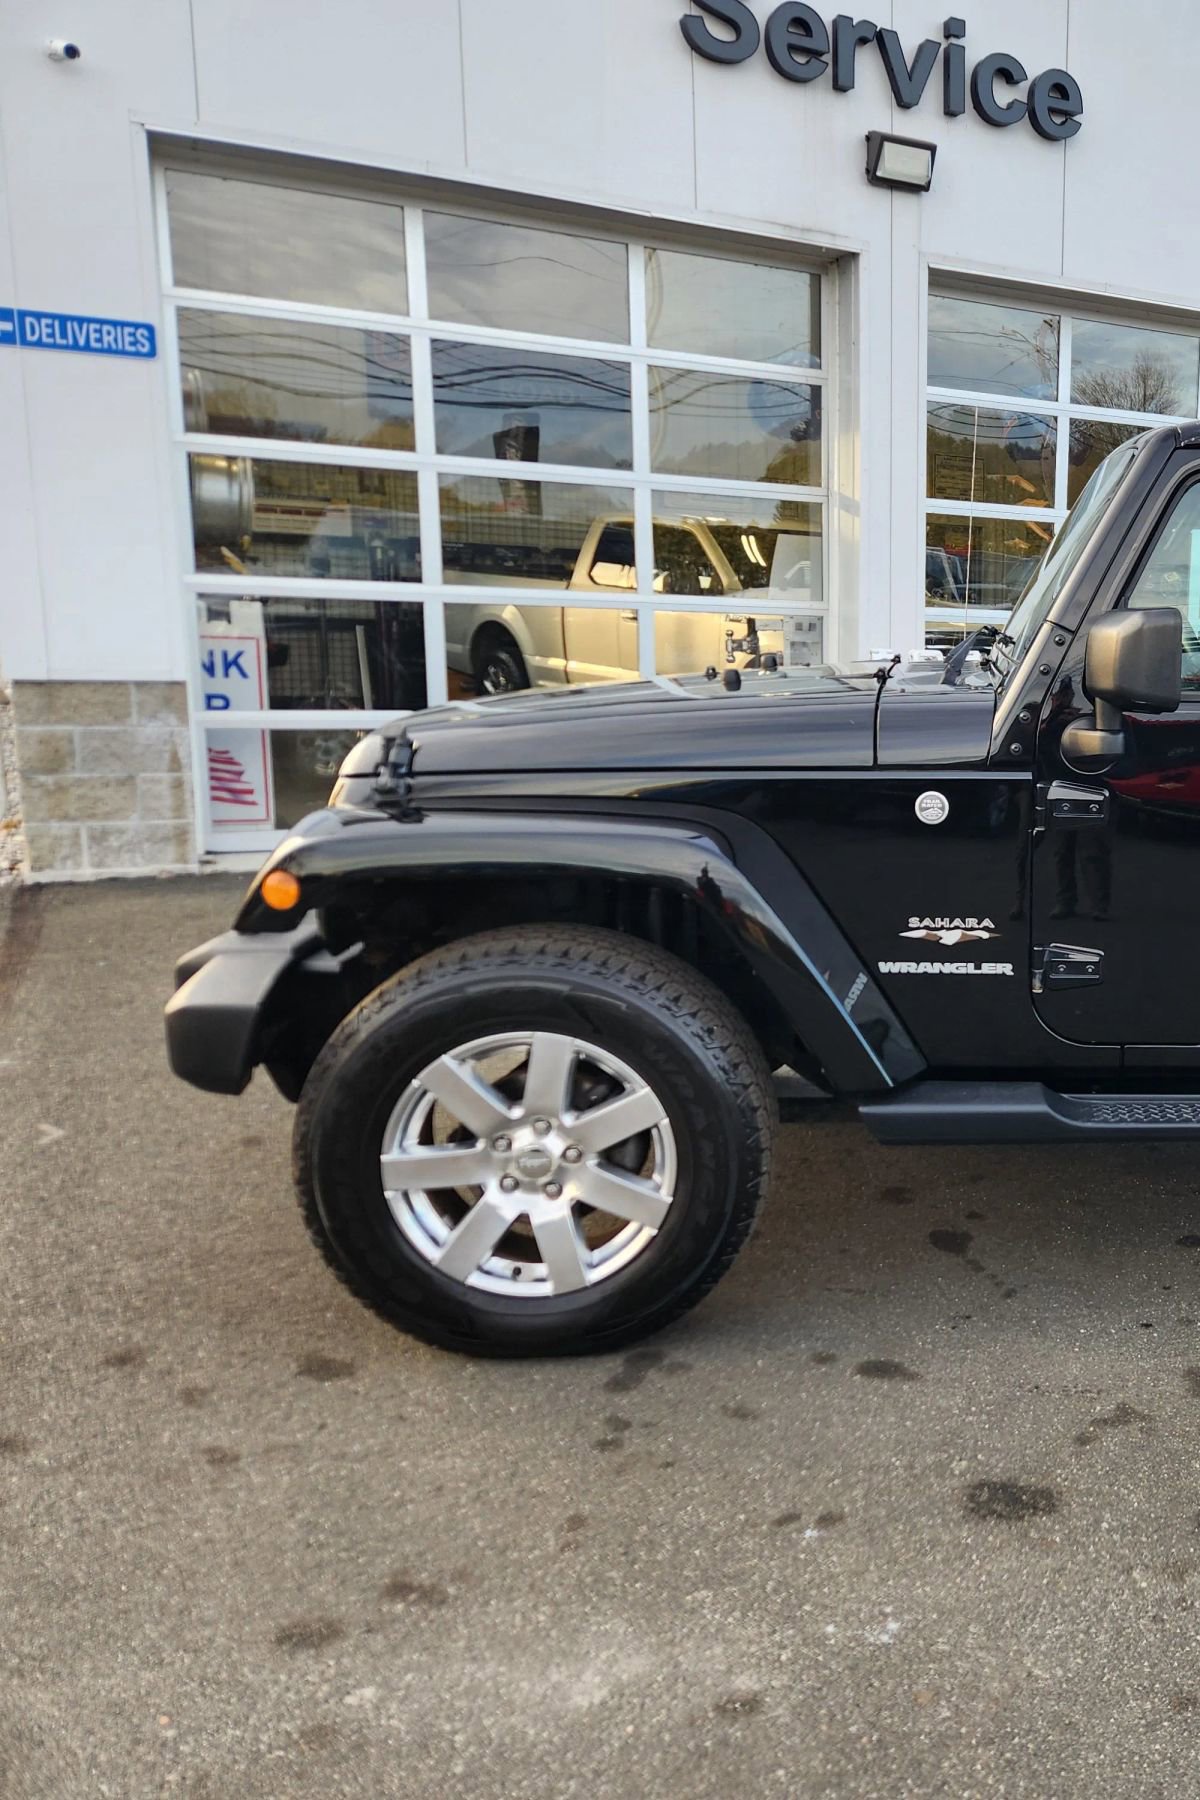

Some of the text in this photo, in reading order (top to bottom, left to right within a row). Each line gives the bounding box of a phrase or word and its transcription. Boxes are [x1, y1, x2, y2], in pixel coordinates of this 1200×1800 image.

[680, 0, 1084, 141] Service
[24, 316, 150, 353] DELIVERIES
[908, 917, 995, 928] SAHARA
[878, 961, 1014, 976] WRANGLER
